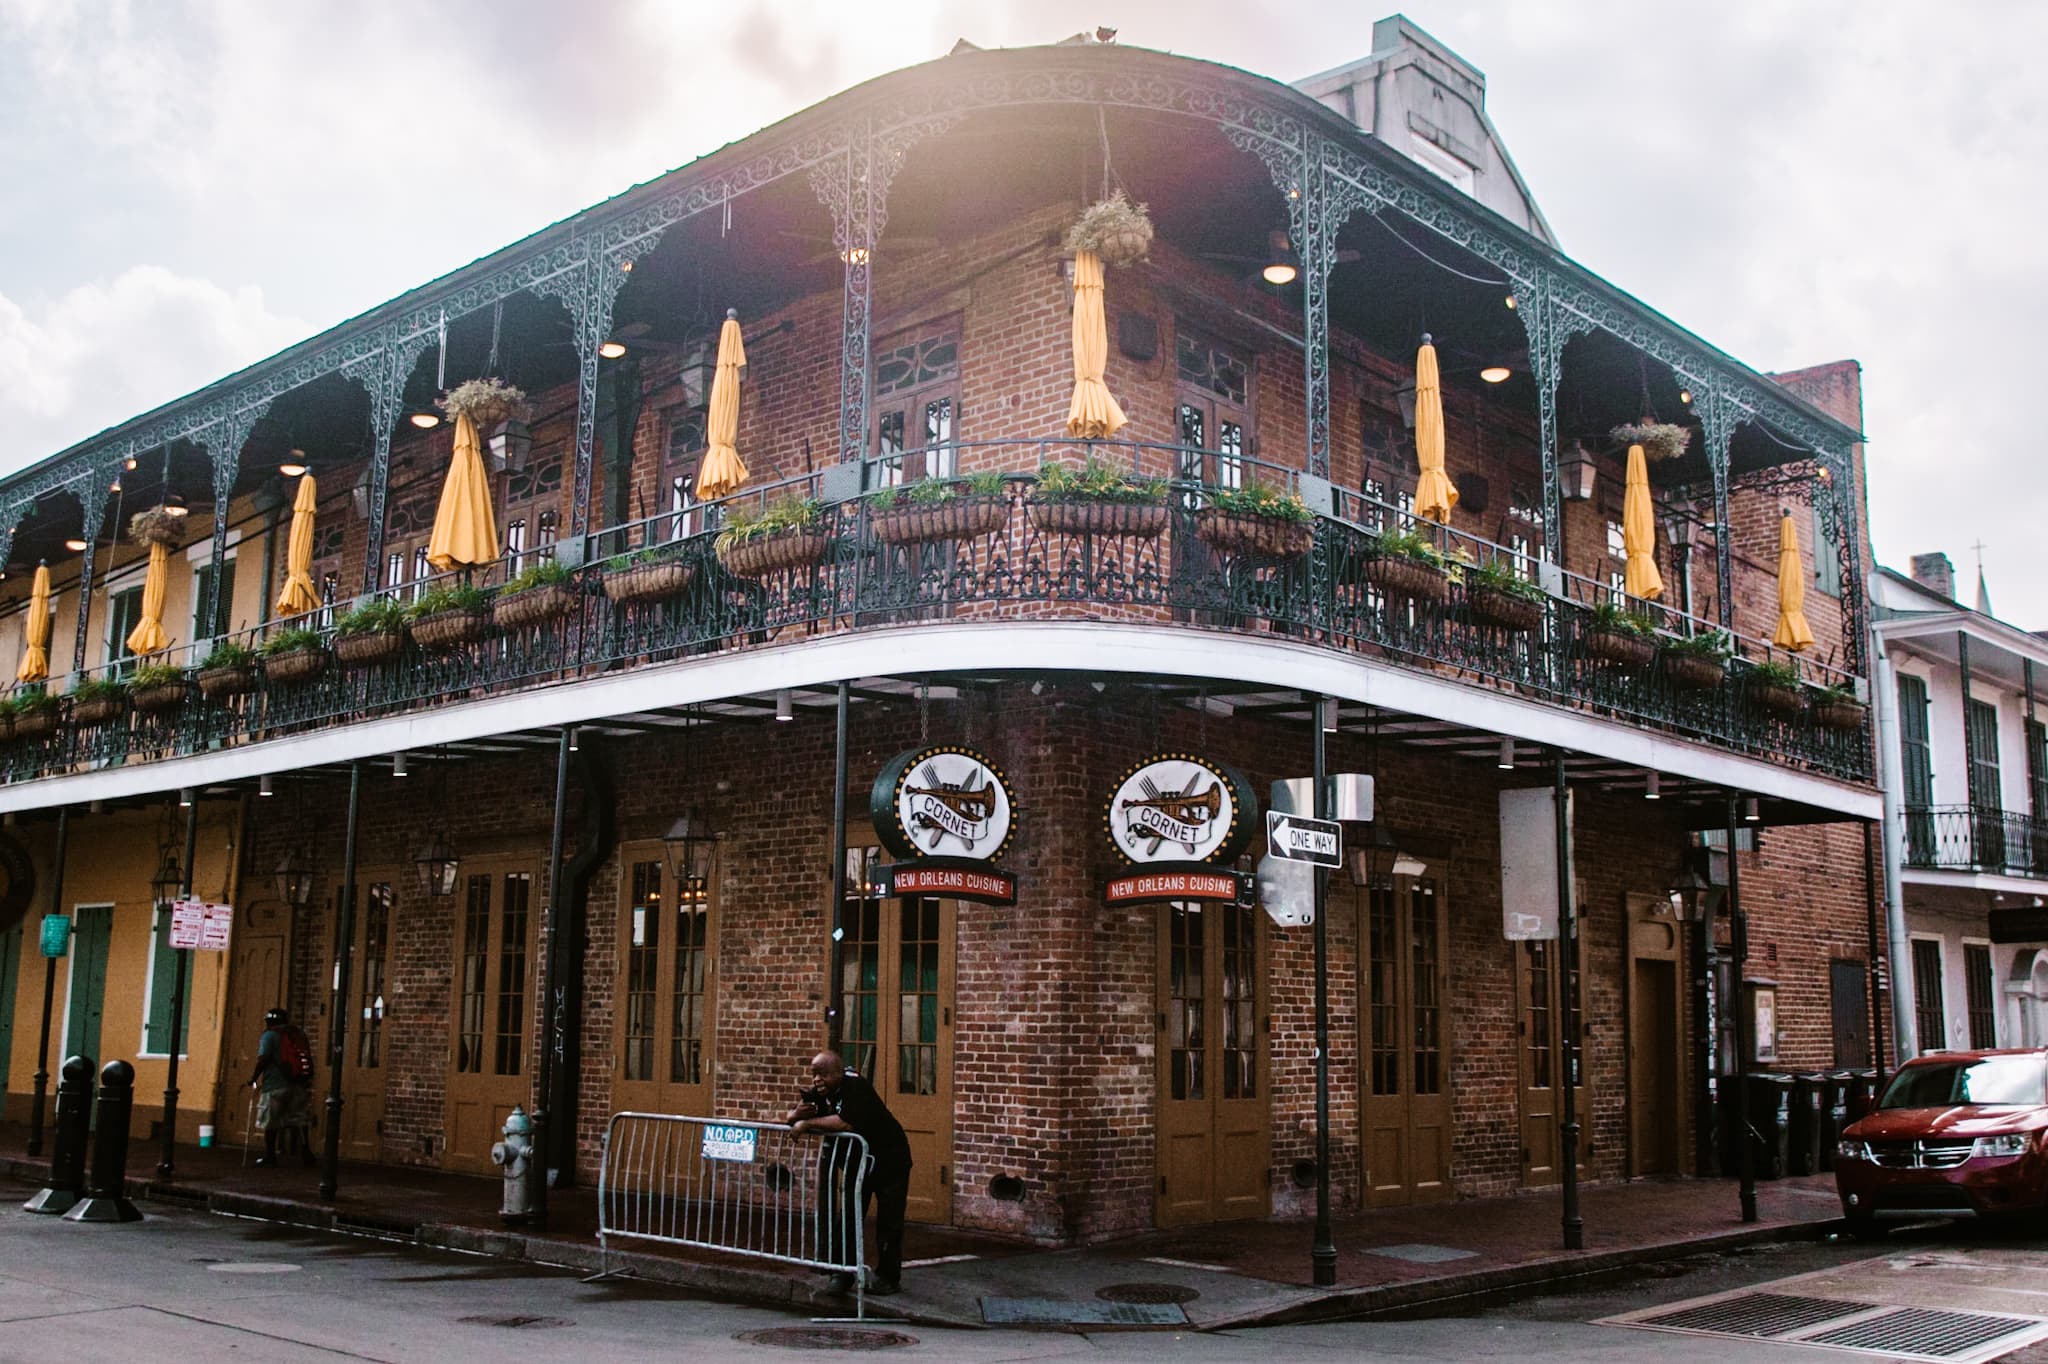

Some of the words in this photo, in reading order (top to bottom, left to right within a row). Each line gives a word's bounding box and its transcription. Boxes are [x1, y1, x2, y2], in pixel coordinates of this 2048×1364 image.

[924, 797, 977, 838] CORNET
[1141, 807, 1200, 841] CORNET
[1290, 830, 1310, 848] ONE
[1314, 833, 1334, 851] WAY
[894, 873, 915, 888] NEW
[920, 872, 963, 886] ORLEANS
[967, 874, 1005, 894] CUISINE
[1112, 882, 1133, 897] NEW
[1138, 877, 1185, 892] ORLEANS
[1190, 877, 1233, 893] CUISINE
